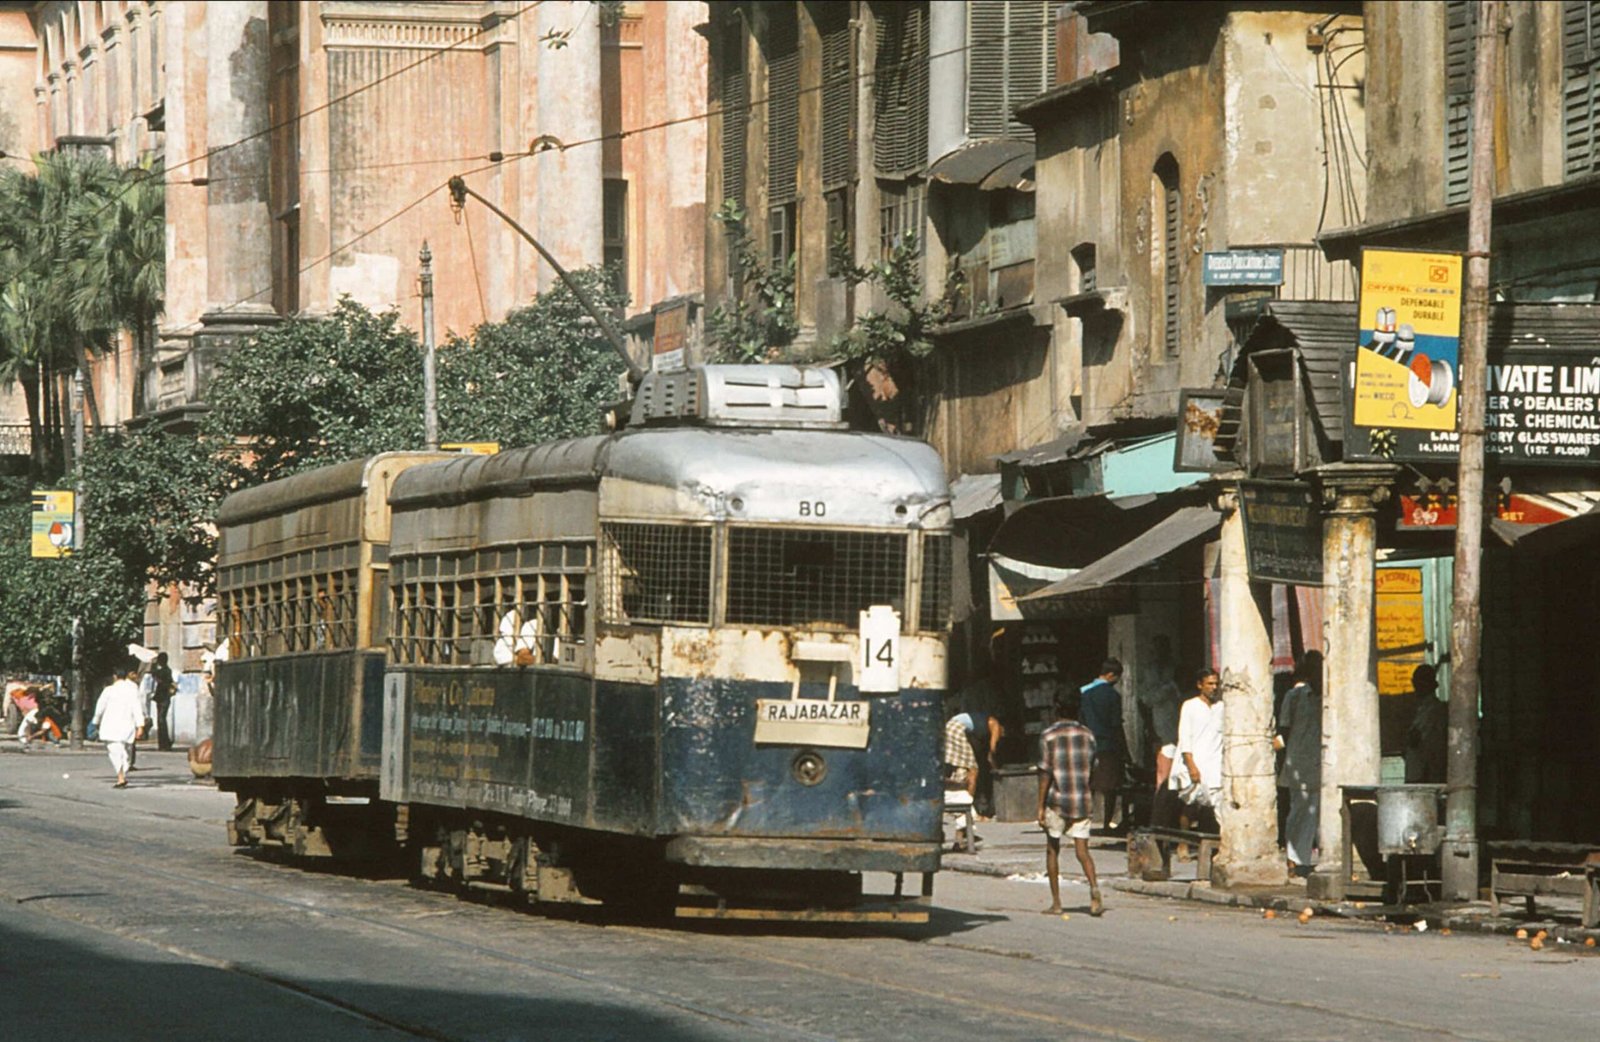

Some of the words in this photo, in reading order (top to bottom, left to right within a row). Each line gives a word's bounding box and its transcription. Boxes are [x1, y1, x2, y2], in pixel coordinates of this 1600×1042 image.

[1366, 283, 1410, 293] CRYSTAL
[1401, 298, 1444, 308] DEPENDABLE
[1413, 310, 1444, 320] DURABLE
[1524, 396, 1594, 411] DEALERS
[799, 500, 826, 517] 80
[865, 638, 893, 668] 14
[768, 704, 860, 720] RAJABAZAR
